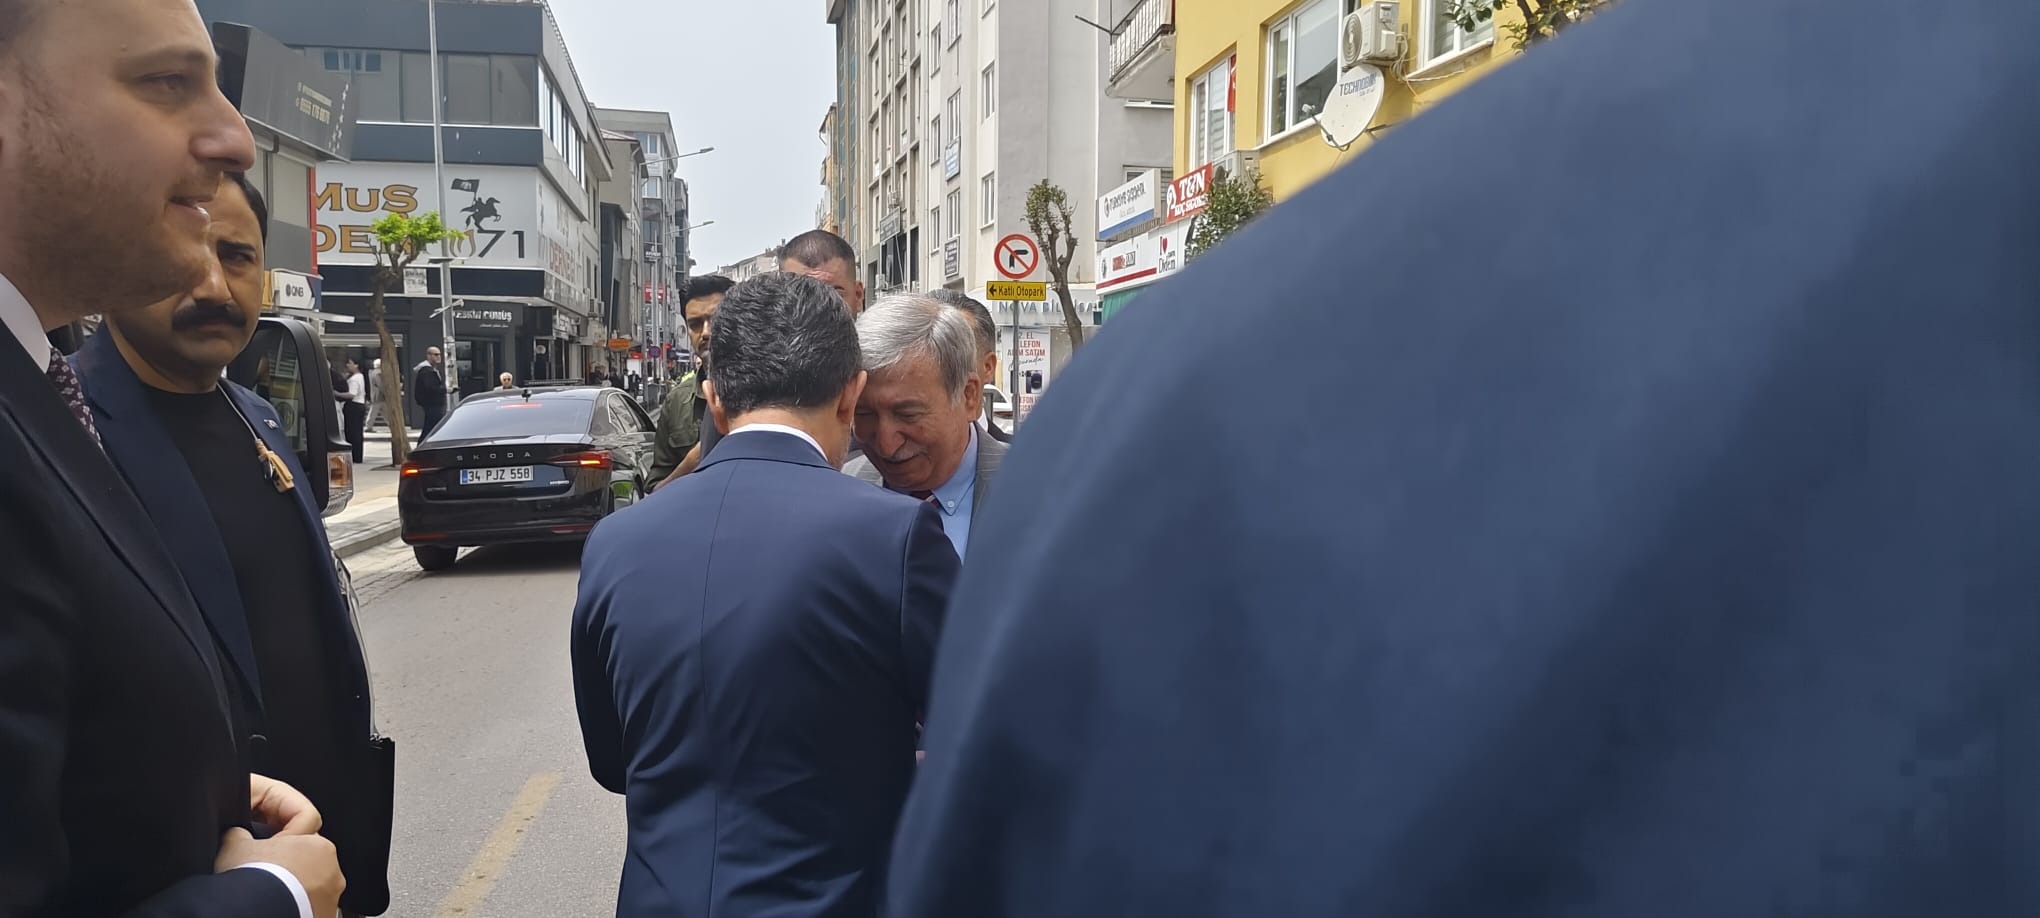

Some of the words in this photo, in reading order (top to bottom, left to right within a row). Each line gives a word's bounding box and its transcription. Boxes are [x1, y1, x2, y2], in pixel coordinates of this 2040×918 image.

[1179, 169, 1206, 201] T&N
[999, 285, 1015, 297] Katlı
[1016, 286, 1044, 299] Otopark
[456, 451, 531, 461] SKODA
[468, 470, 481, 482] 34
[486, 469, 506, 481] PJZ
[510, 467, 530, 480] 558
